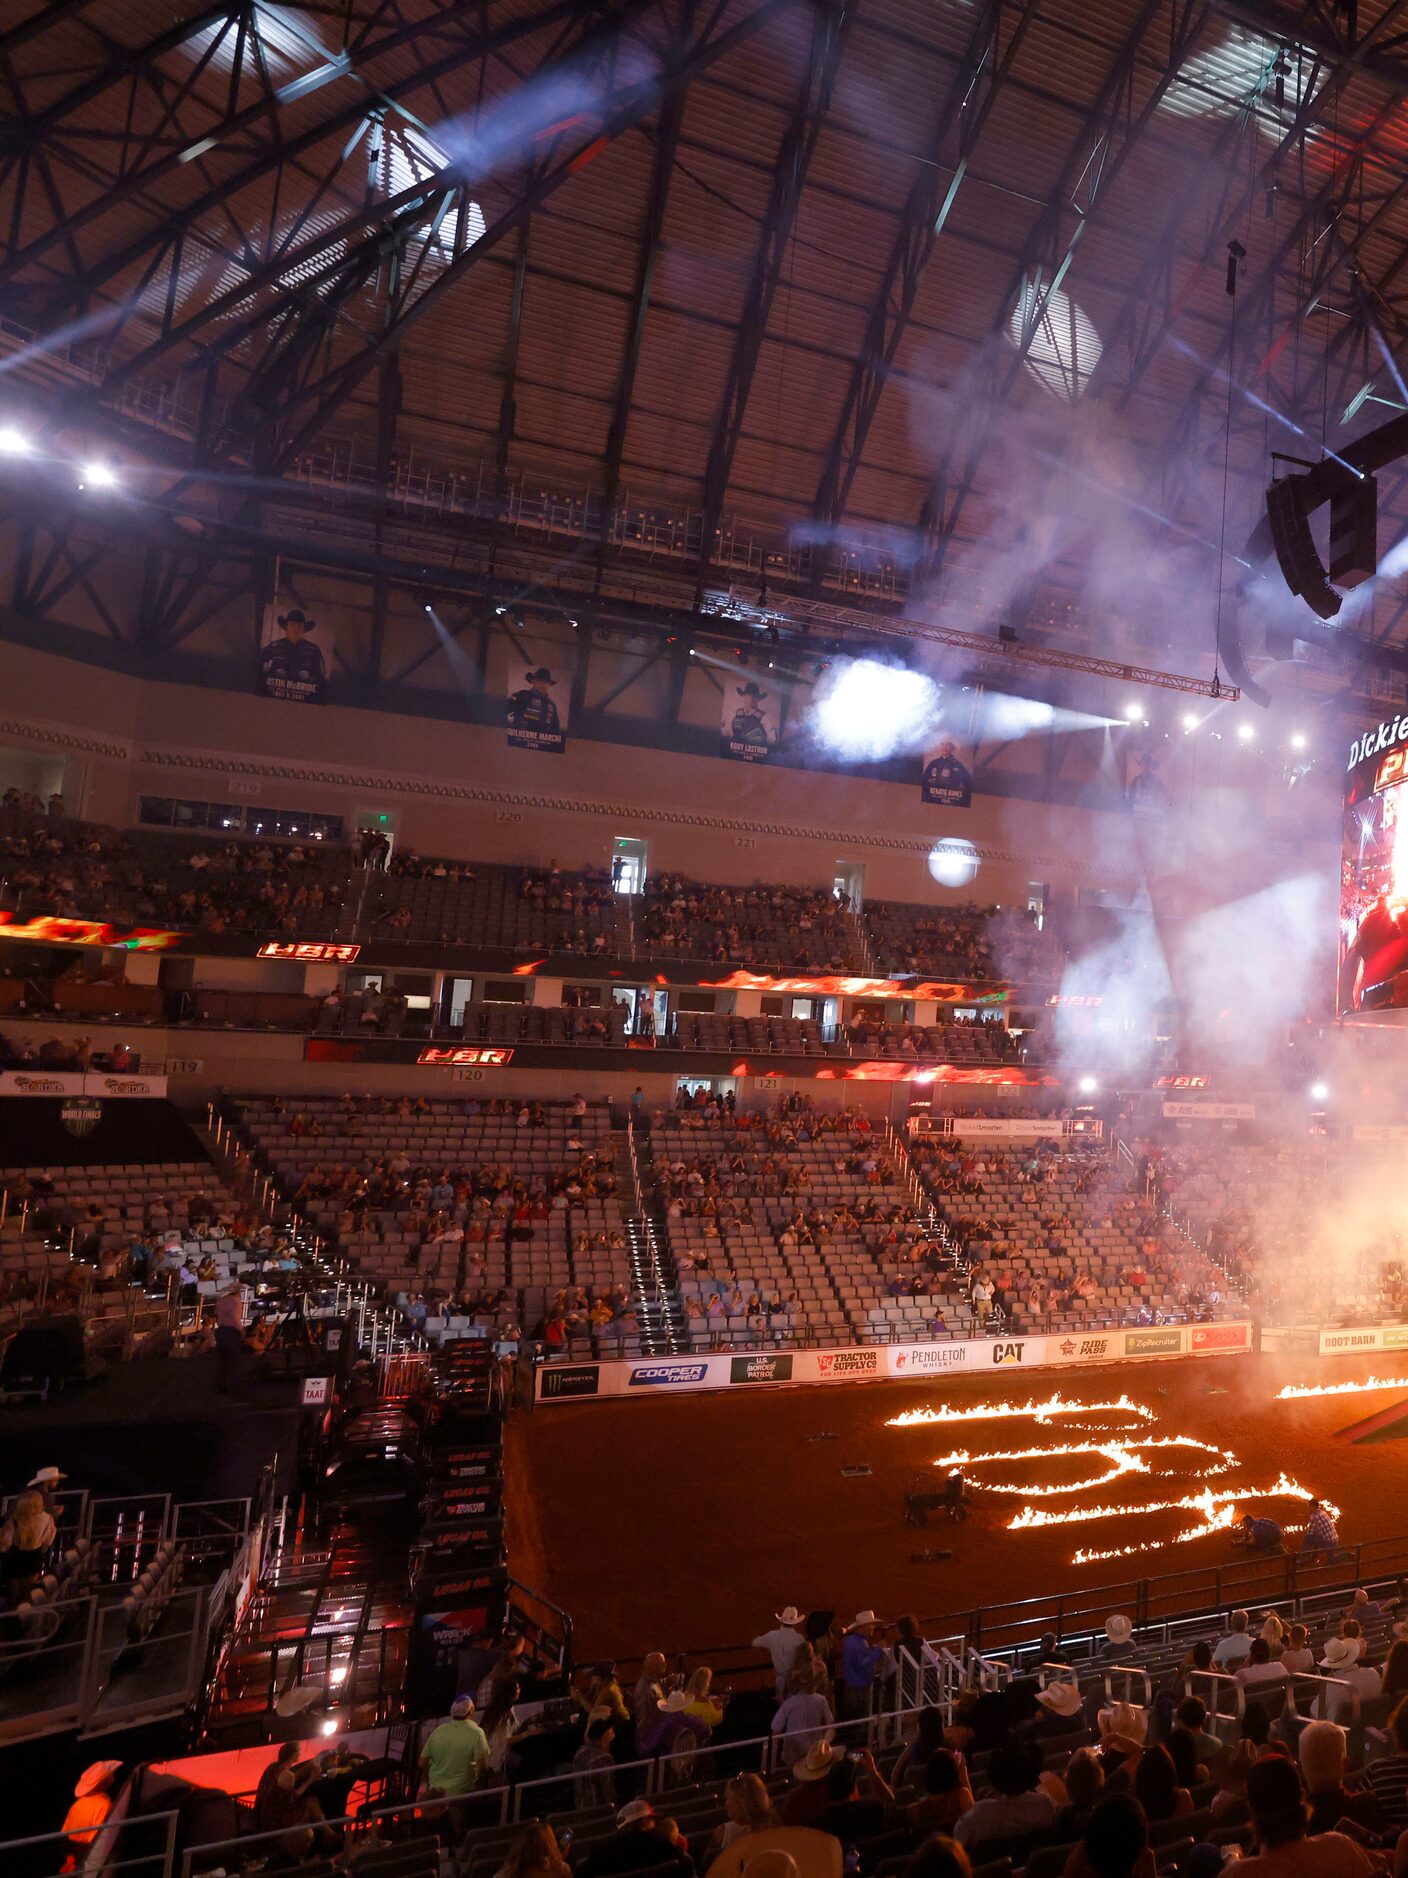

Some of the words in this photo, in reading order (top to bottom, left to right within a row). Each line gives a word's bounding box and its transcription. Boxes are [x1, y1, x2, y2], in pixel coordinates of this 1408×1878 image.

[499, 812, 522, 822] 220
[737, 838, 756, 848] 221
[172, 1061, 197, 1072] 119
[458, 1069, 482, 1080] 120
[760, 1079, 777, 1090] 121
[61, 1109, 83, 1120] WORLD
[83, 1110, 102, 1120] FINALS
[1082, 1340, 1108, 1348] RIDE
[1136, 1337, 1178, 1348] ZipRecruiter
[1325, 1337, 1349, 1347] BOOT
[1351, 1335, 1376, 1346] BARN
[912, 1347, 966, 1364] PENDLETON
[993, 1343, 1026, 1364] CAT
[1079, 1346, 1106, 1355] PASS
[818, 1356, 832, 1369] TSC
[834, 1352, 877, 1363] TRACTOR
[634, 1365, 703, 1378] COOPER
[747, 1363, 776, 1372] BORDER
[833, 1361, 866, 1371] SUPPLY
[561, 1375, 594, 1383] MONSTER
[667, 1374, 700, 1382] TIRES
[746, 1370, 774, 1379] PATROL
[306, 1389, 324, 1399] TAAT
[473, 1576, 492, 1590] OIL
